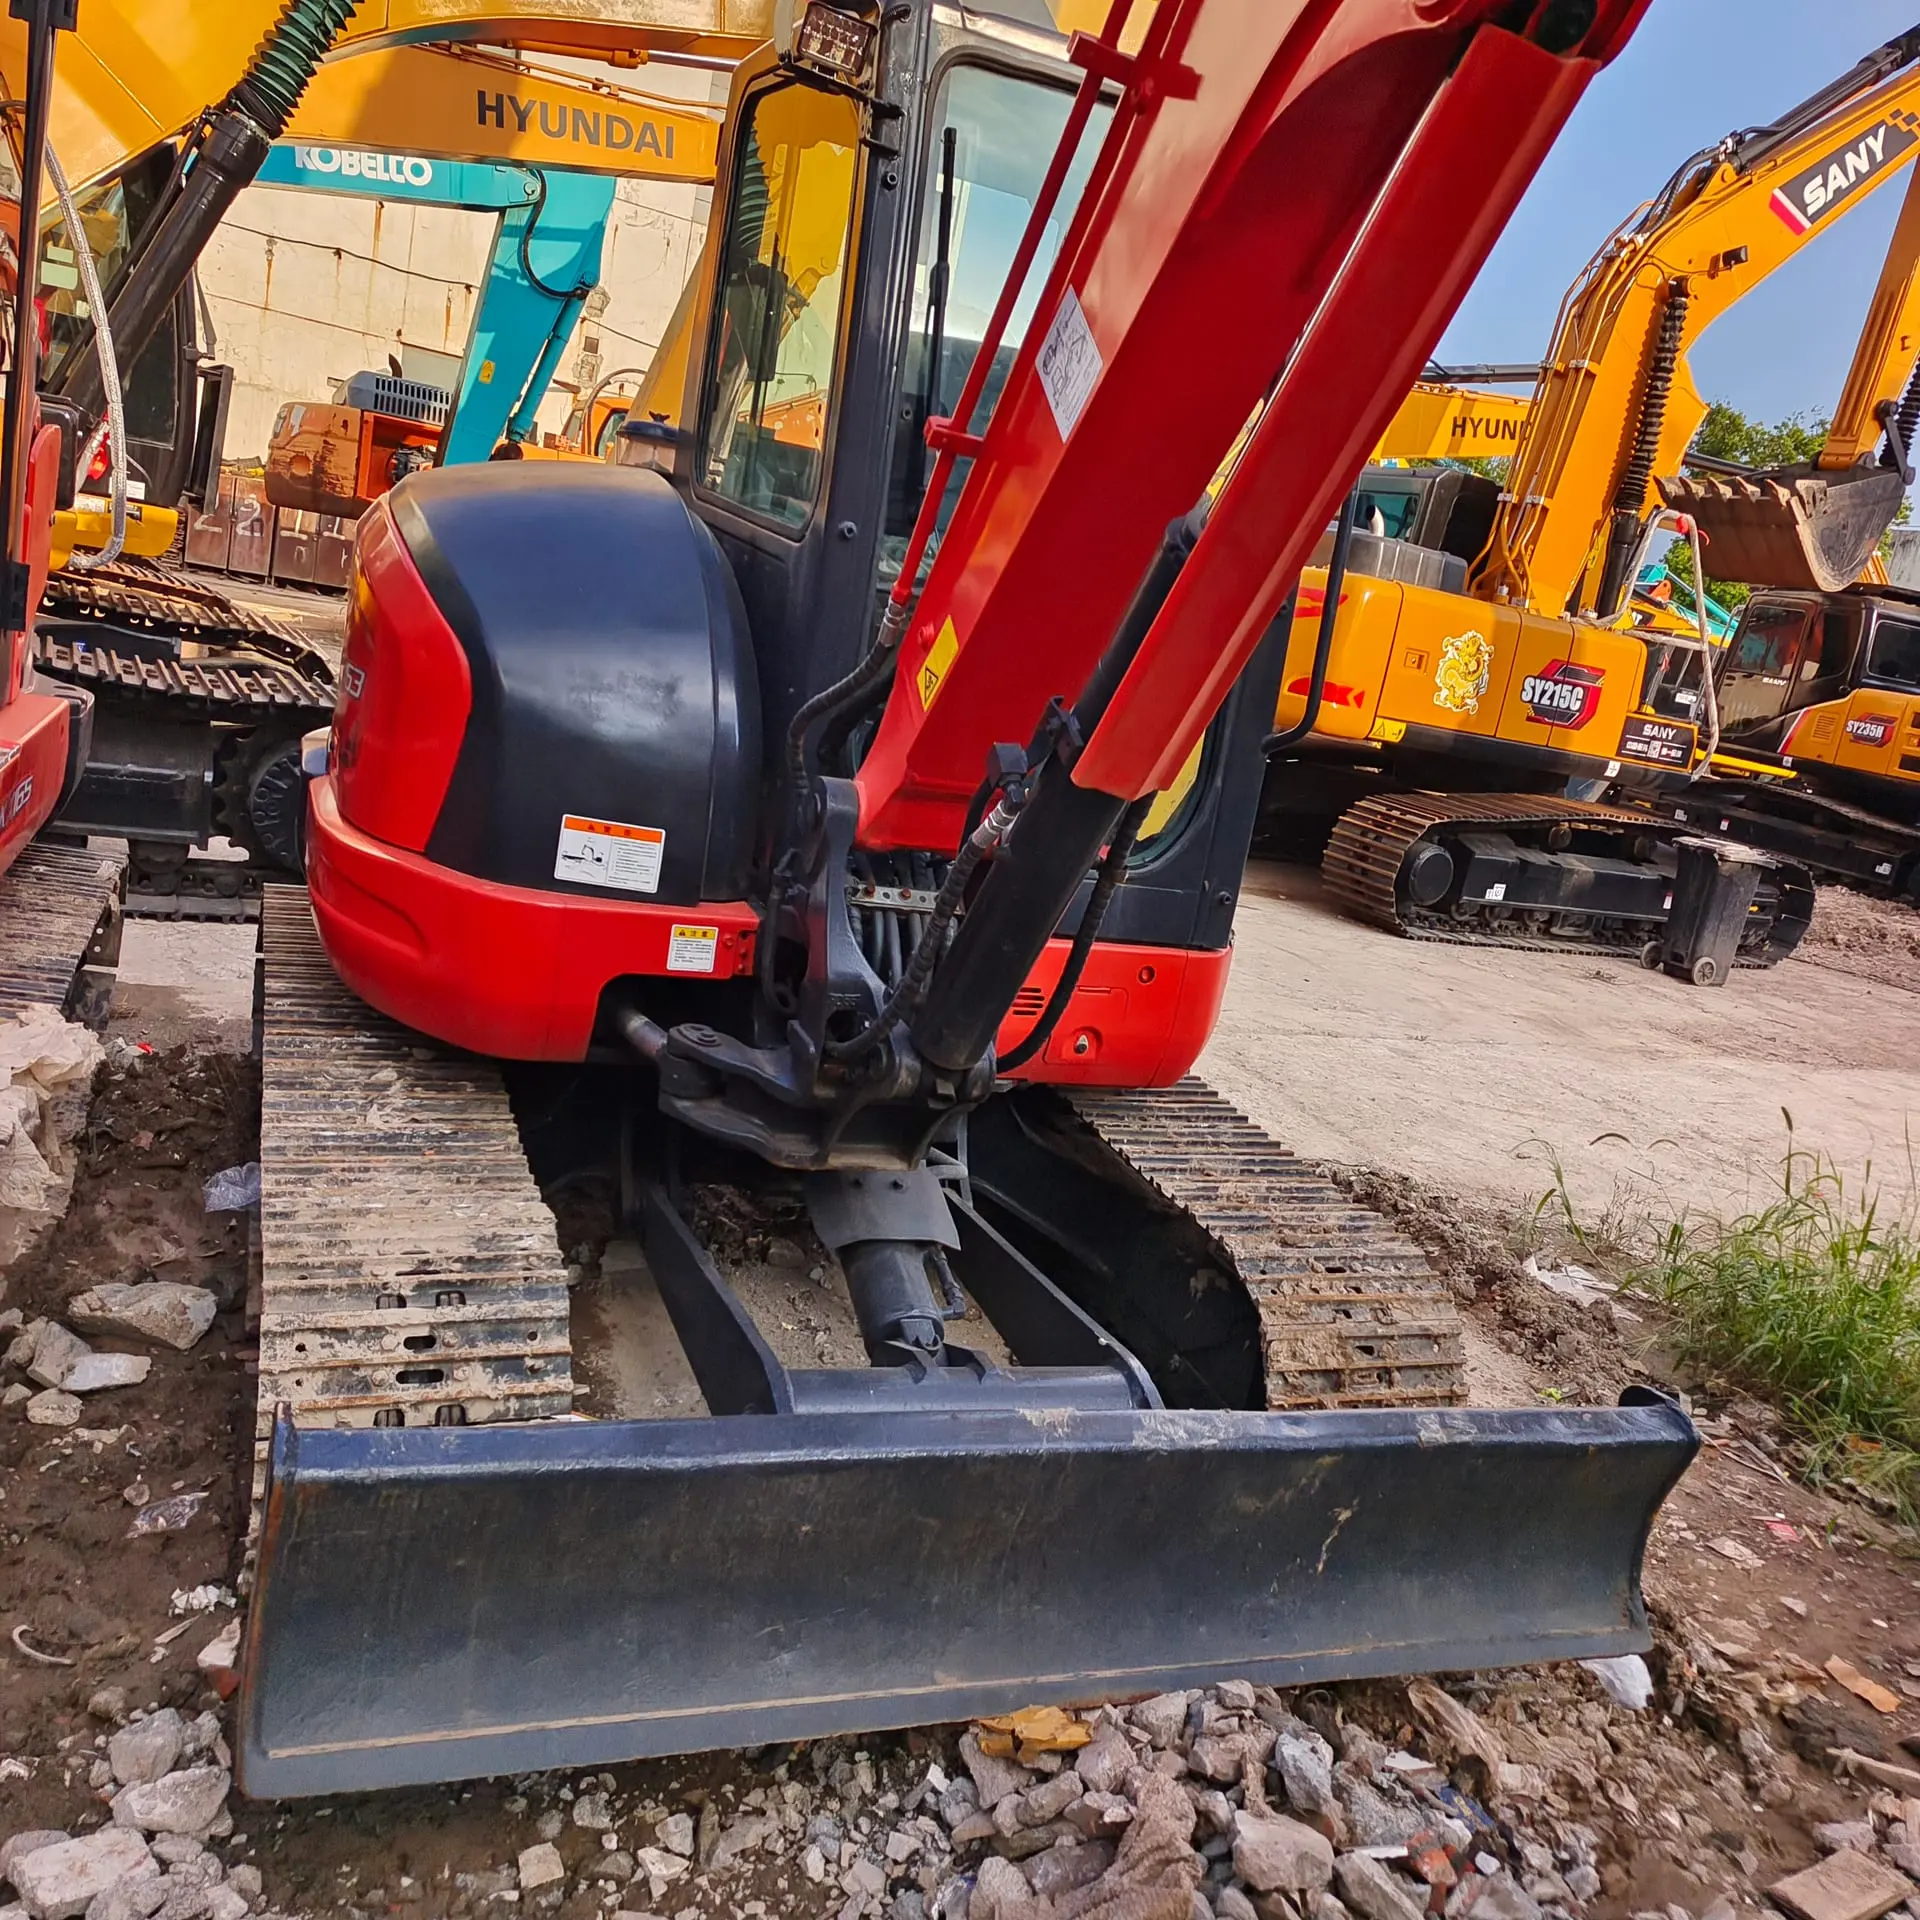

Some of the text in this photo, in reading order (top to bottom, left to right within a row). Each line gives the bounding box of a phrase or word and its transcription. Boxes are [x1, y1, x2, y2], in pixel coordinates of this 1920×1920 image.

[477, 89, 674, 159] HYUNDAI
[295, 145, 432, 186] KOBELCO
[1803, 124, 1886, 217] SANY
[1521, 676, 1584, 712] SY215C
[1642, 723, 1677, 740] SANY
[1846, 720, 1885, 738] SY235H
